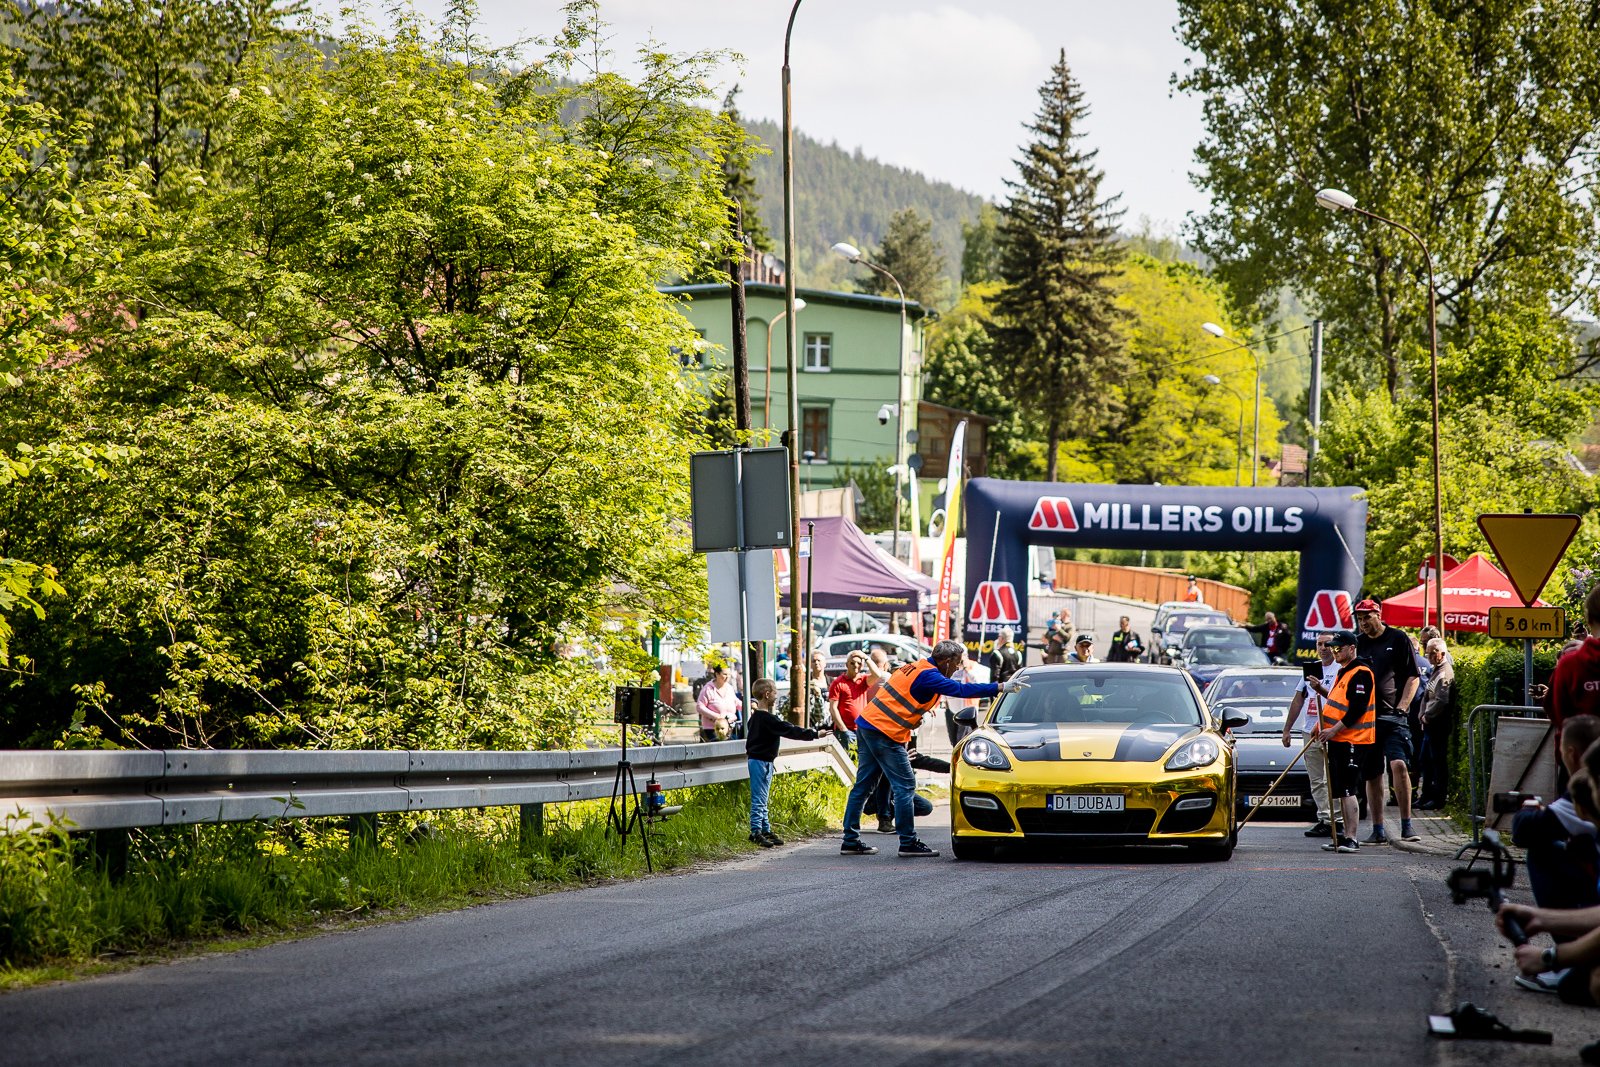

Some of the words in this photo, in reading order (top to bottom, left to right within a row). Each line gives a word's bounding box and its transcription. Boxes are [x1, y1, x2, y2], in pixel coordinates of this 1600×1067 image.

[1083, 502, 1223, 532] MILLERS
[1231, 506, 1303, 532] OILS
[1505, 617, 1528, 632] 5,0
[1532, 618, 1551, 631] km
[1056, 796, 1070, 809] D1
[1078, 797, 1120, 809] DUBAJ
[1268, 797, 1298, 805] 916MM
